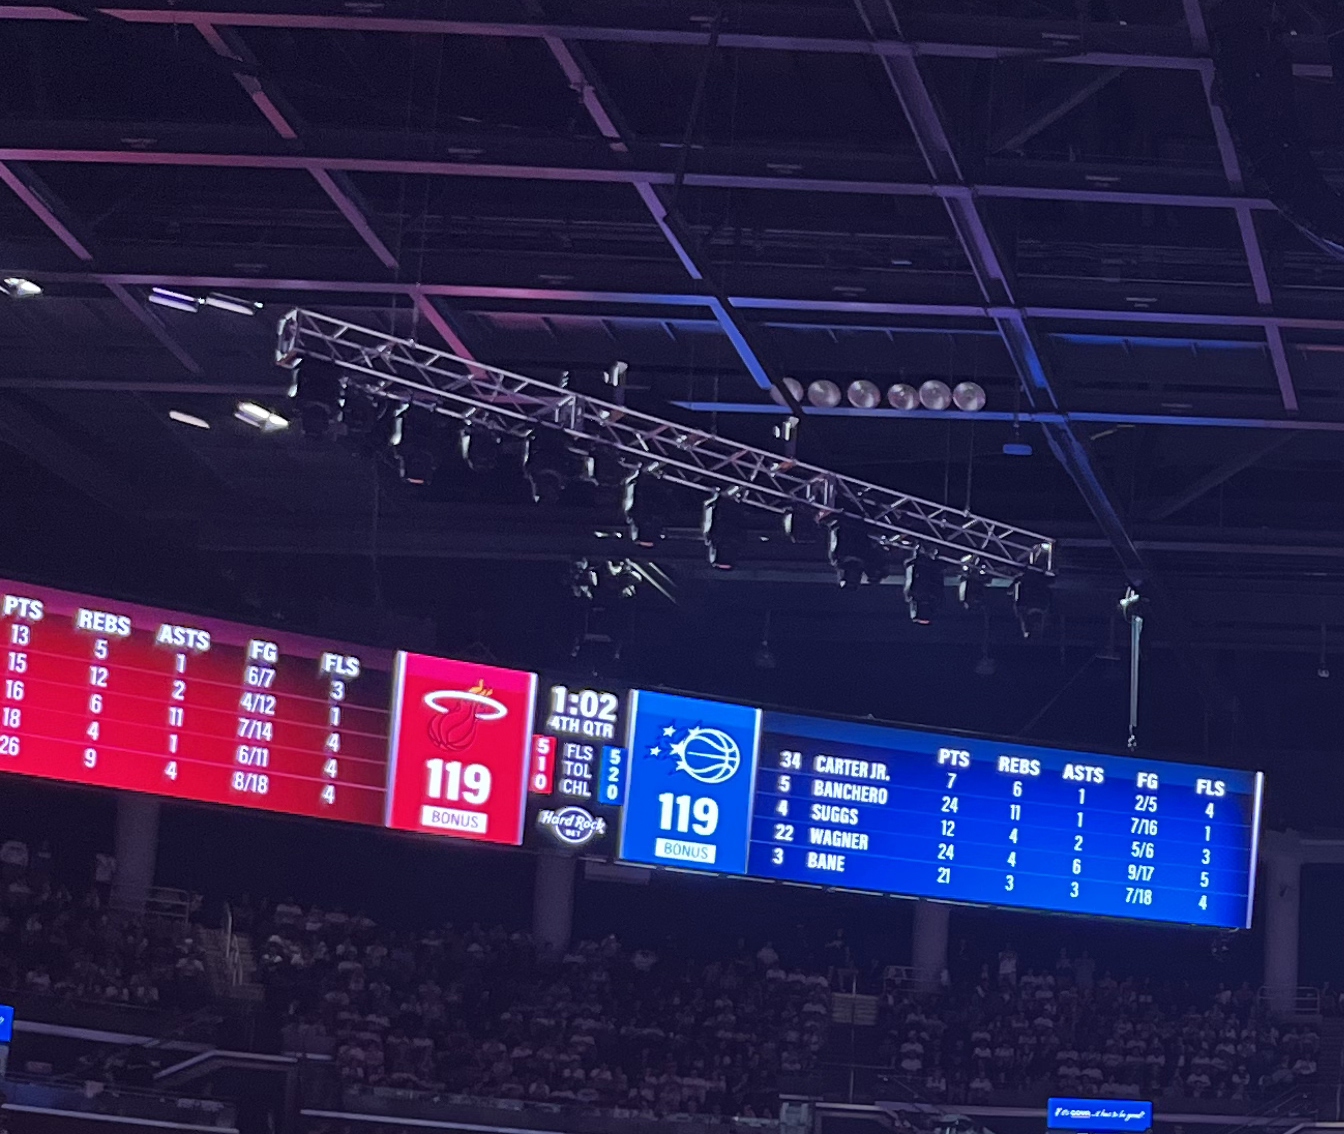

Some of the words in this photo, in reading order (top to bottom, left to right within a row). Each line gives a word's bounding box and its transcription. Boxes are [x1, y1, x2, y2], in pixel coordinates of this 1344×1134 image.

[551, 685, 618, 722] 1:02
[426, 758, 492, 805] 119
[812, 779, 888, 805] BANCHERO
[658, 792, 719, 836] 119
